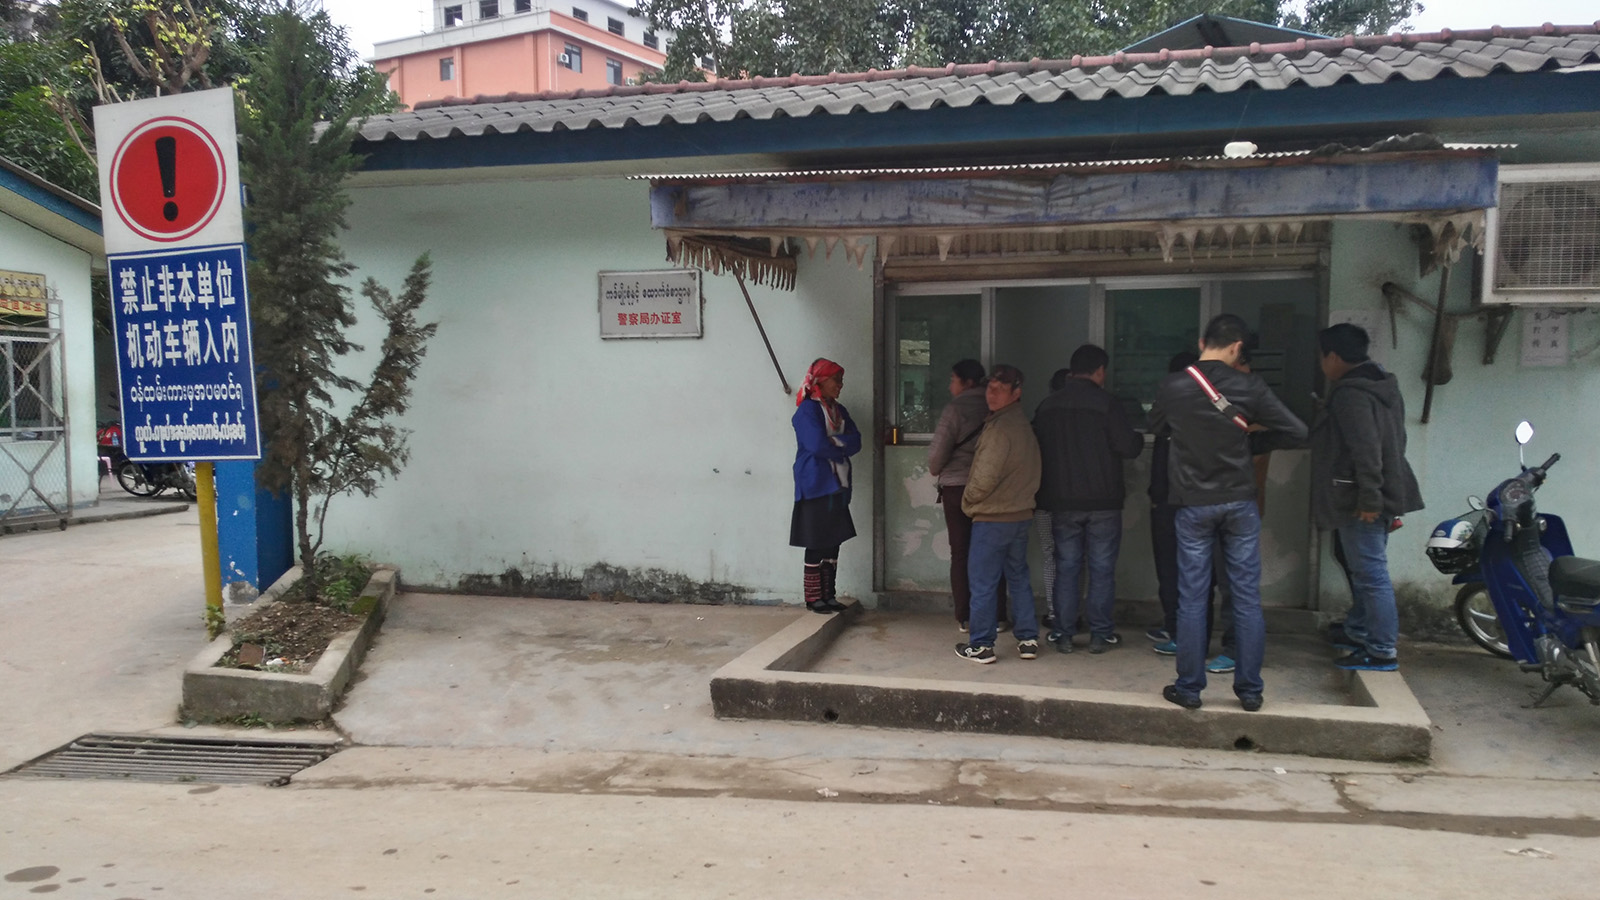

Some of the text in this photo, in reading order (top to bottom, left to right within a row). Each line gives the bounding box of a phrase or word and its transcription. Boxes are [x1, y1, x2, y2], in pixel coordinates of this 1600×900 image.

[120, 260, 235, 315] 禁止非本单位
[126, 315, 239, 369] 机动车辆入内
[617, 311, 682, 326] 警察局办证室
